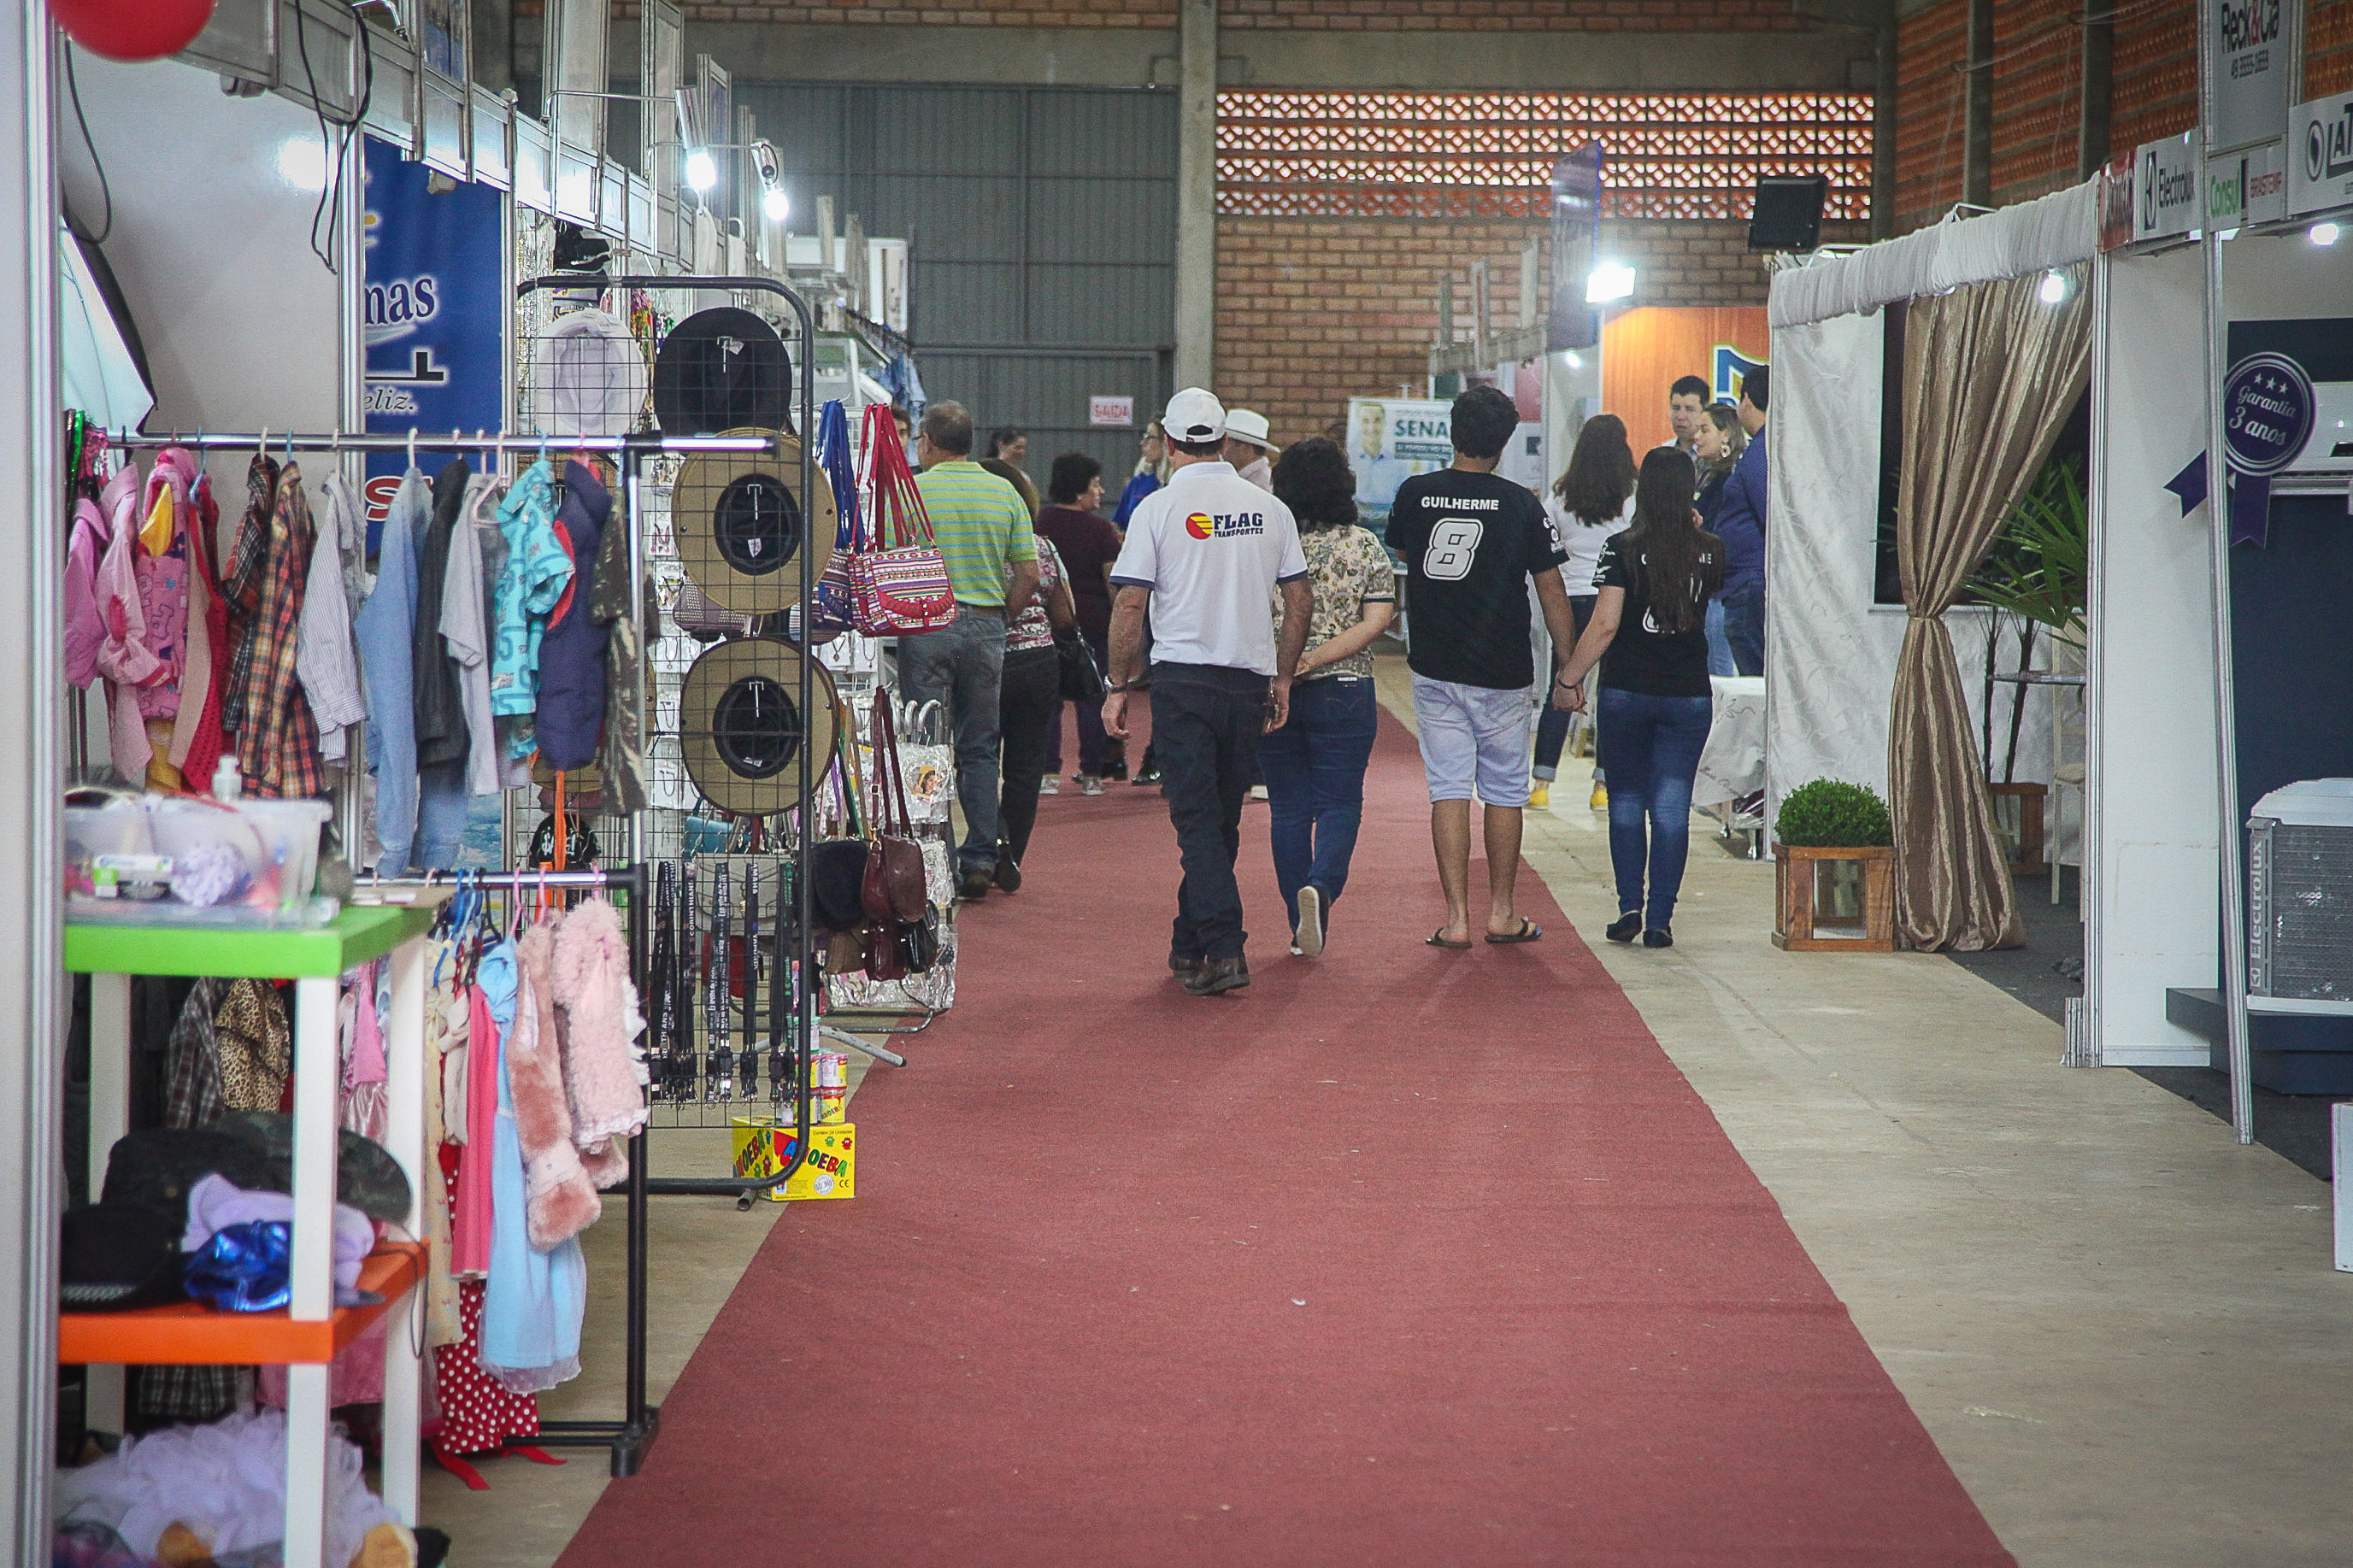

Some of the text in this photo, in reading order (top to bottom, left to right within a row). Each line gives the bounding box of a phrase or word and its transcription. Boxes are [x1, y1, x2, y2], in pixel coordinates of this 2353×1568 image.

[2238, 385, 2296, 417] Garantia
[2229, 407, 2285, 445] 3 anos
[1421, 496, 1500, 510] GUILHERME
[1213, 513, 1263, 530] FLAG
[1214, 527, 1264, 538] TRANSPORTES
[1422, 517, 1484, 581] 8
[2251, 840, 2262, 959] Electrolux
[782, 1139, 848, 1177] AOEBA
